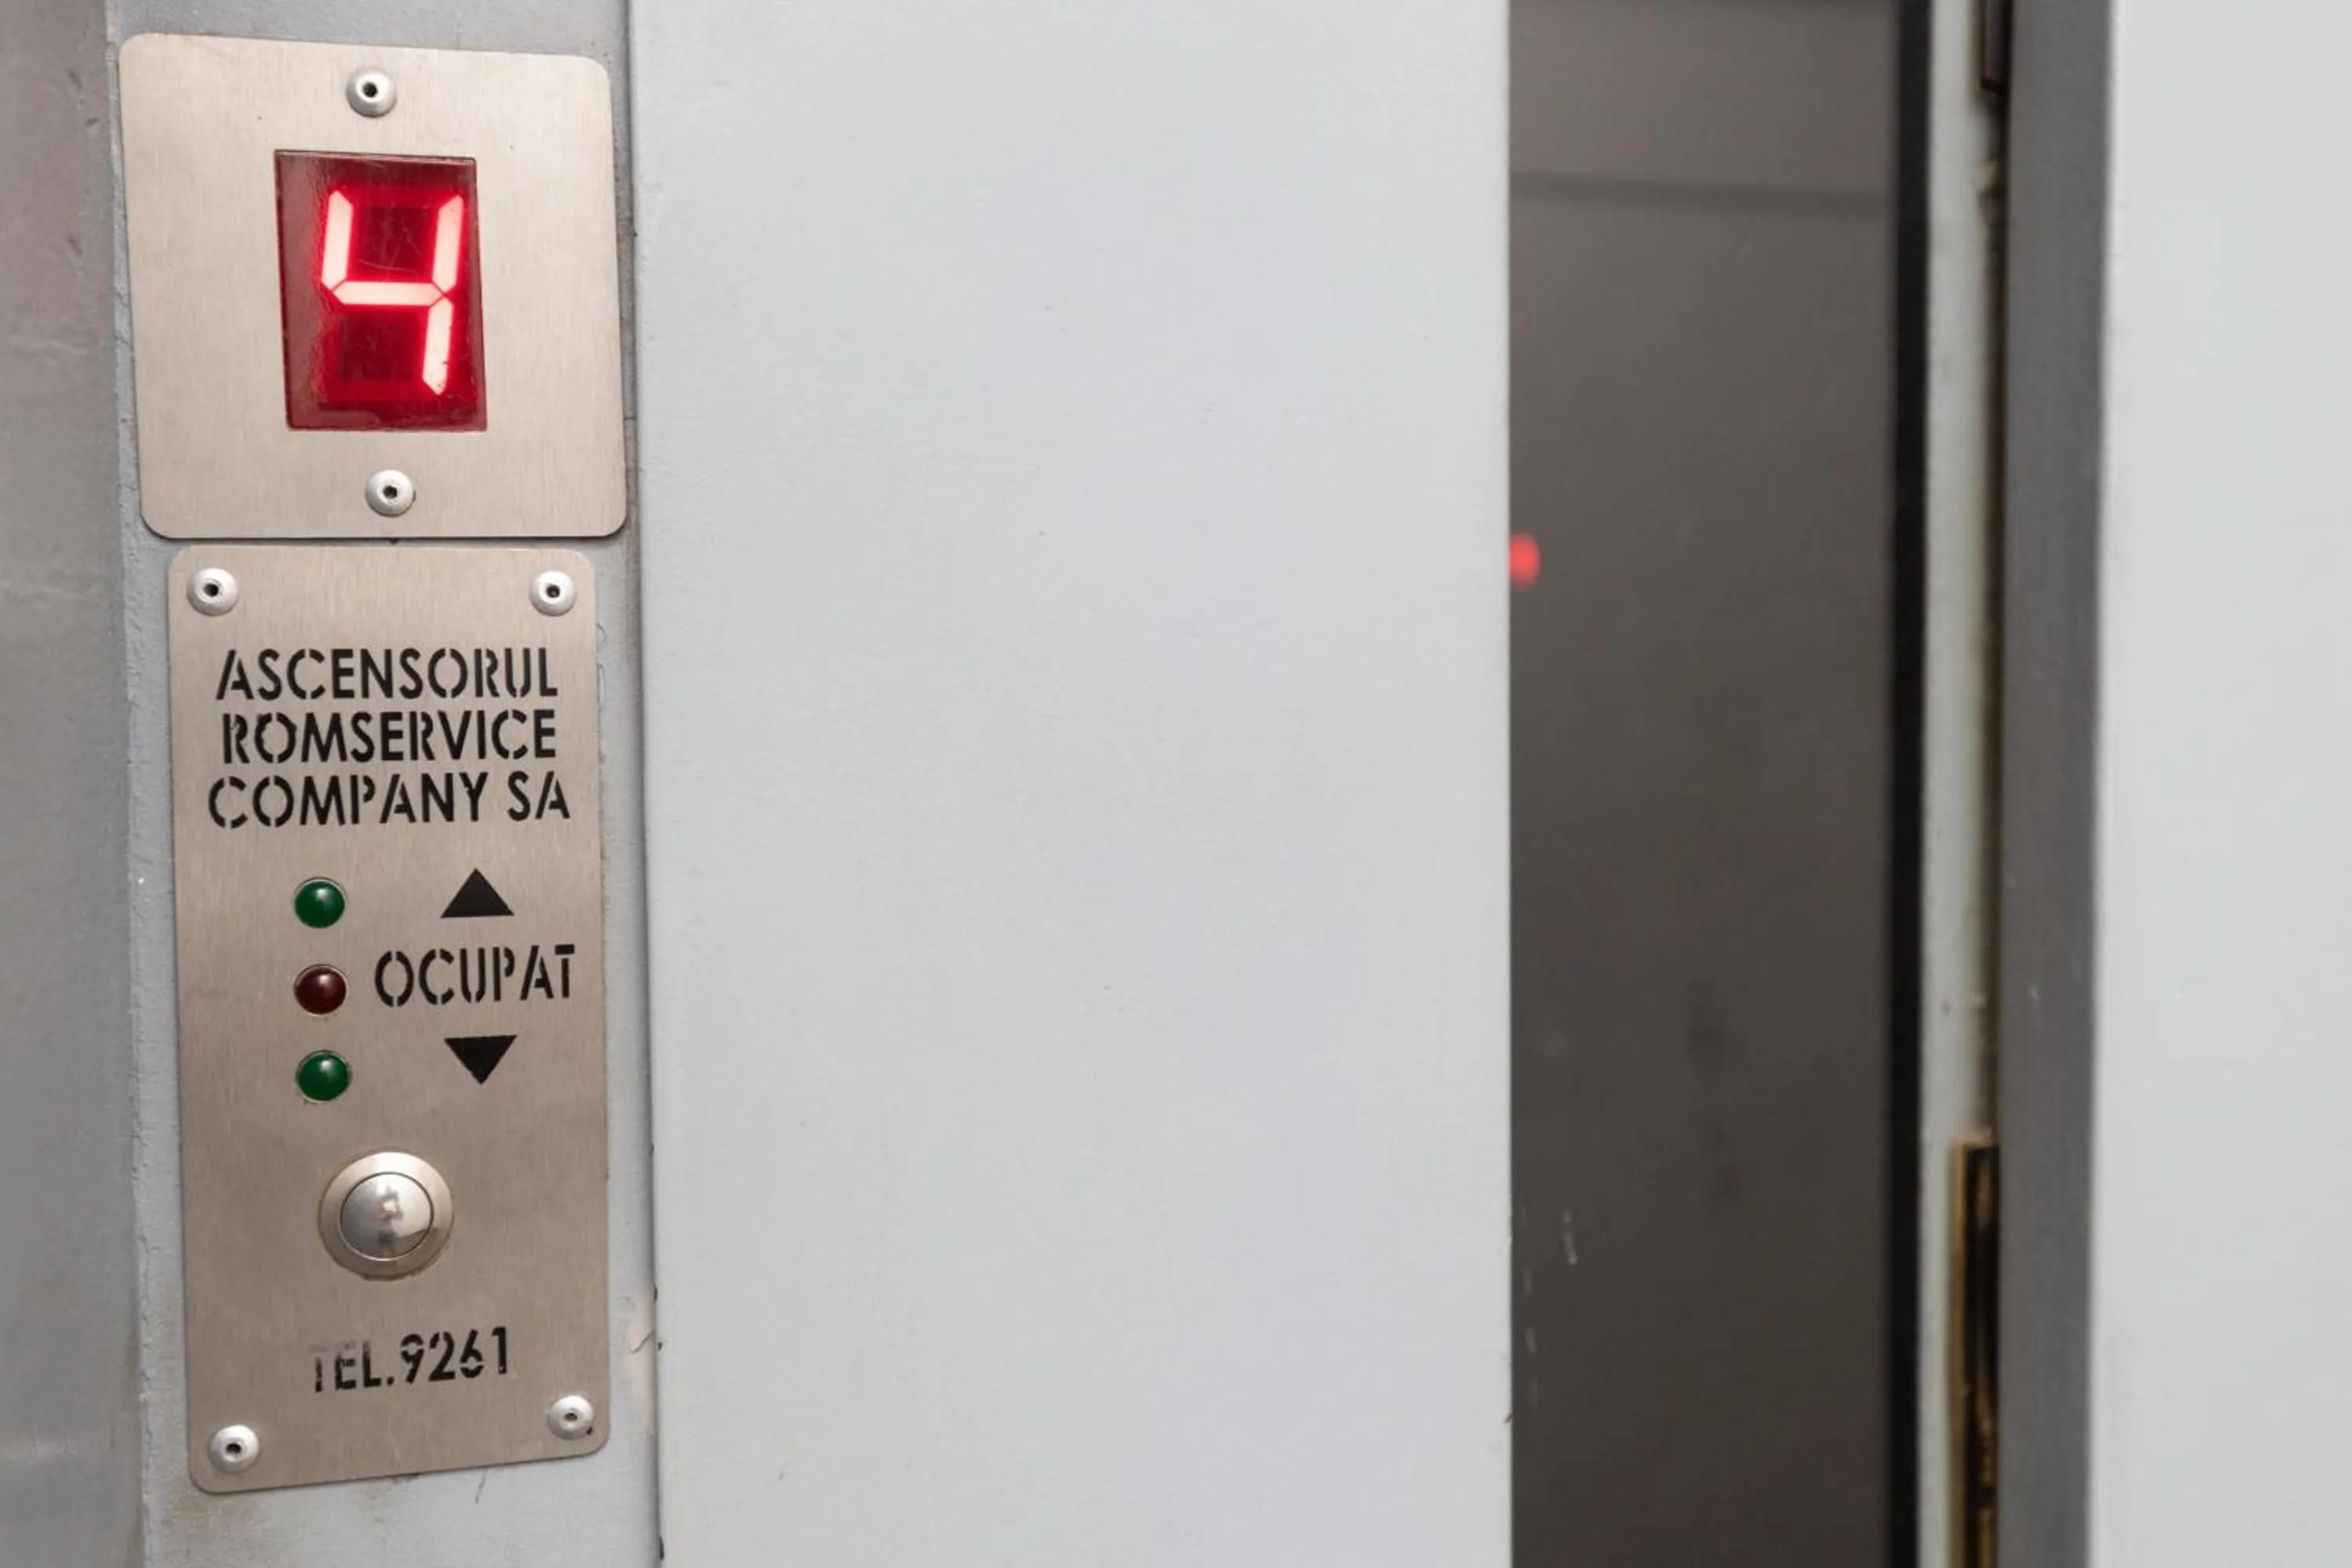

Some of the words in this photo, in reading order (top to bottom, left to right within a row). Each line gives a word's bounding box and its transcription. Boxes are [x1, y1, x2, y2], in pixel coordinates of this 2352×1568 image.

[321, 189, 463, 395] 4
[216, 648, 558, 701] ASCENSORUL
[223, 710, 557, 764] ROMSERVICE
[209, 772, 488, 829] COMPANY
[506, 771, 571, 821] SA
[374, 944, 575, 1007] OCUPAT
